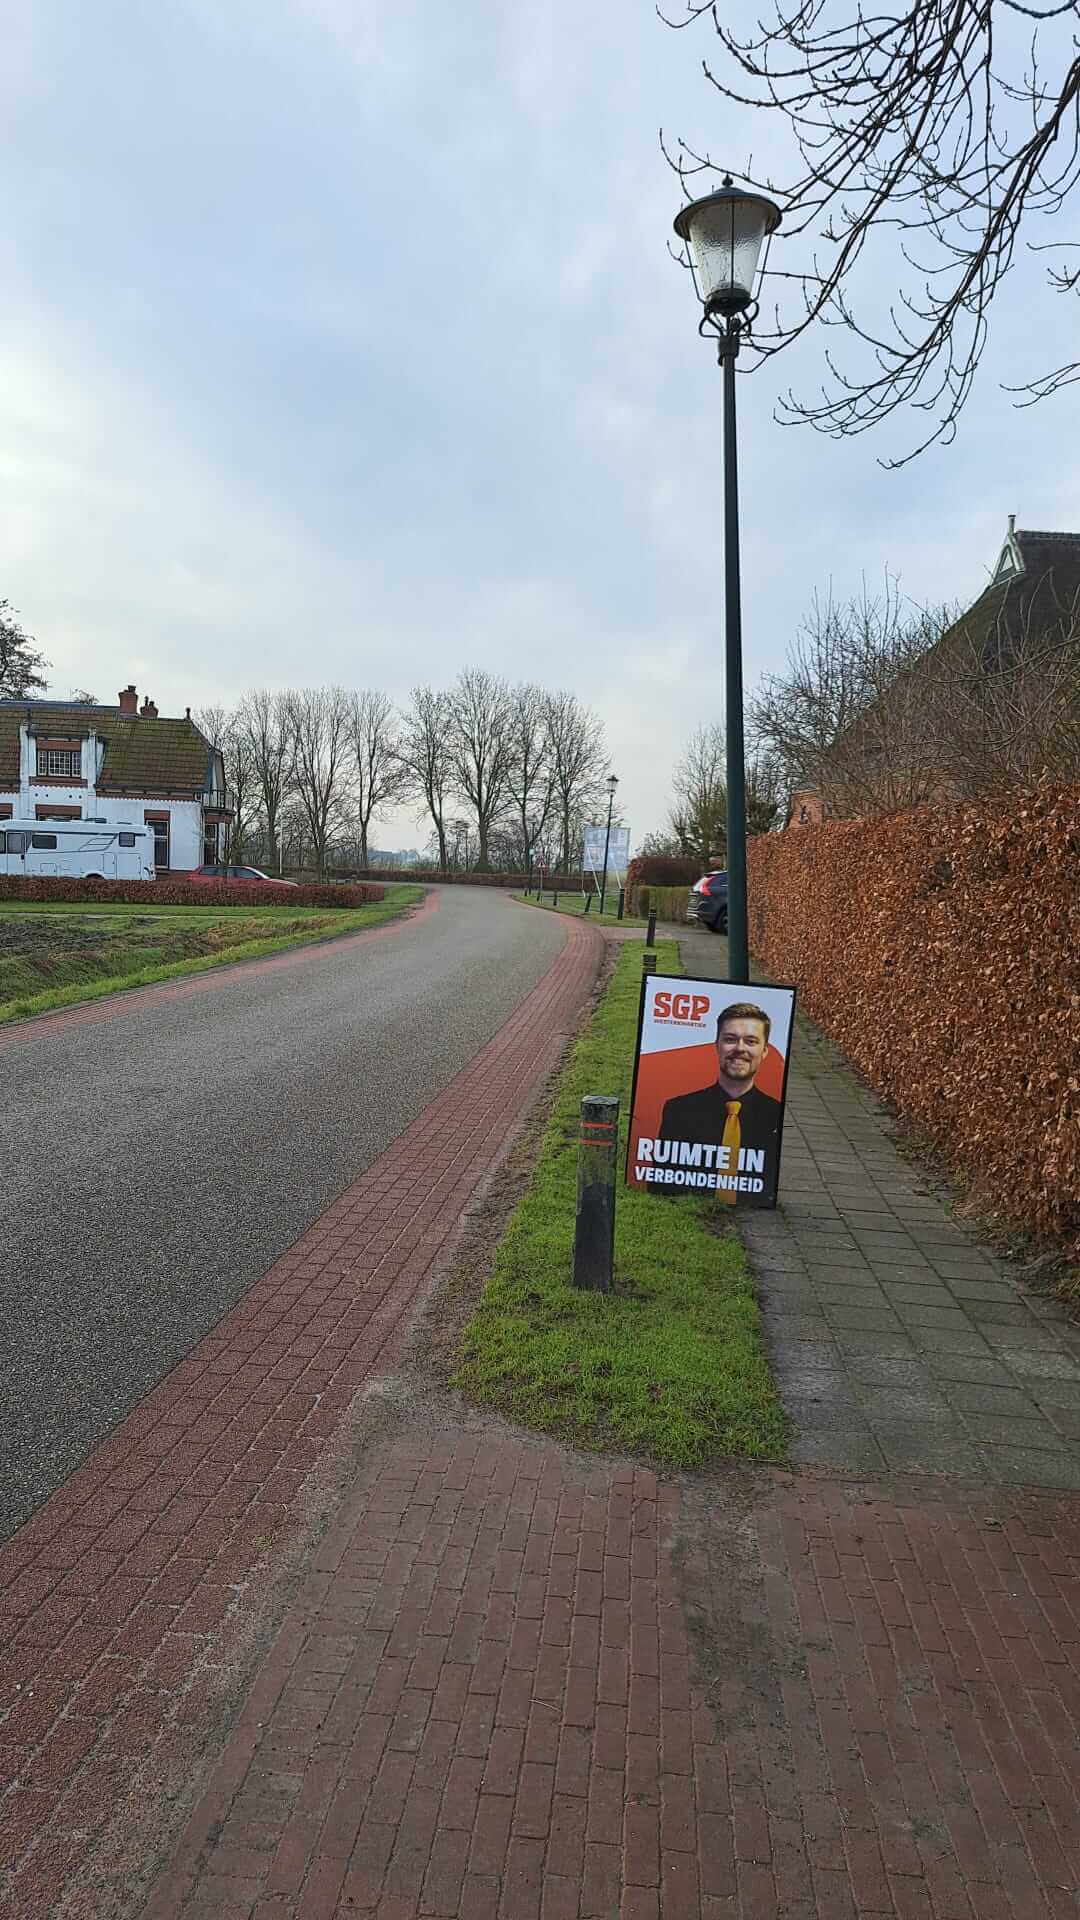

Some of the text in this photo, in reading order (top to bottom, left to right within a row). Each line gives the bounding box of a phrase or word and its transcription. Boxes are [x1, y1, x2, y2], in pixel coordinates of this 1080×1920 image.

[654, 992, 710, 1021] SGP
[637, 1138, 765, 1173] RUIMTE IN
[635, 1166, 764, 1192] VERBONDENHEID
